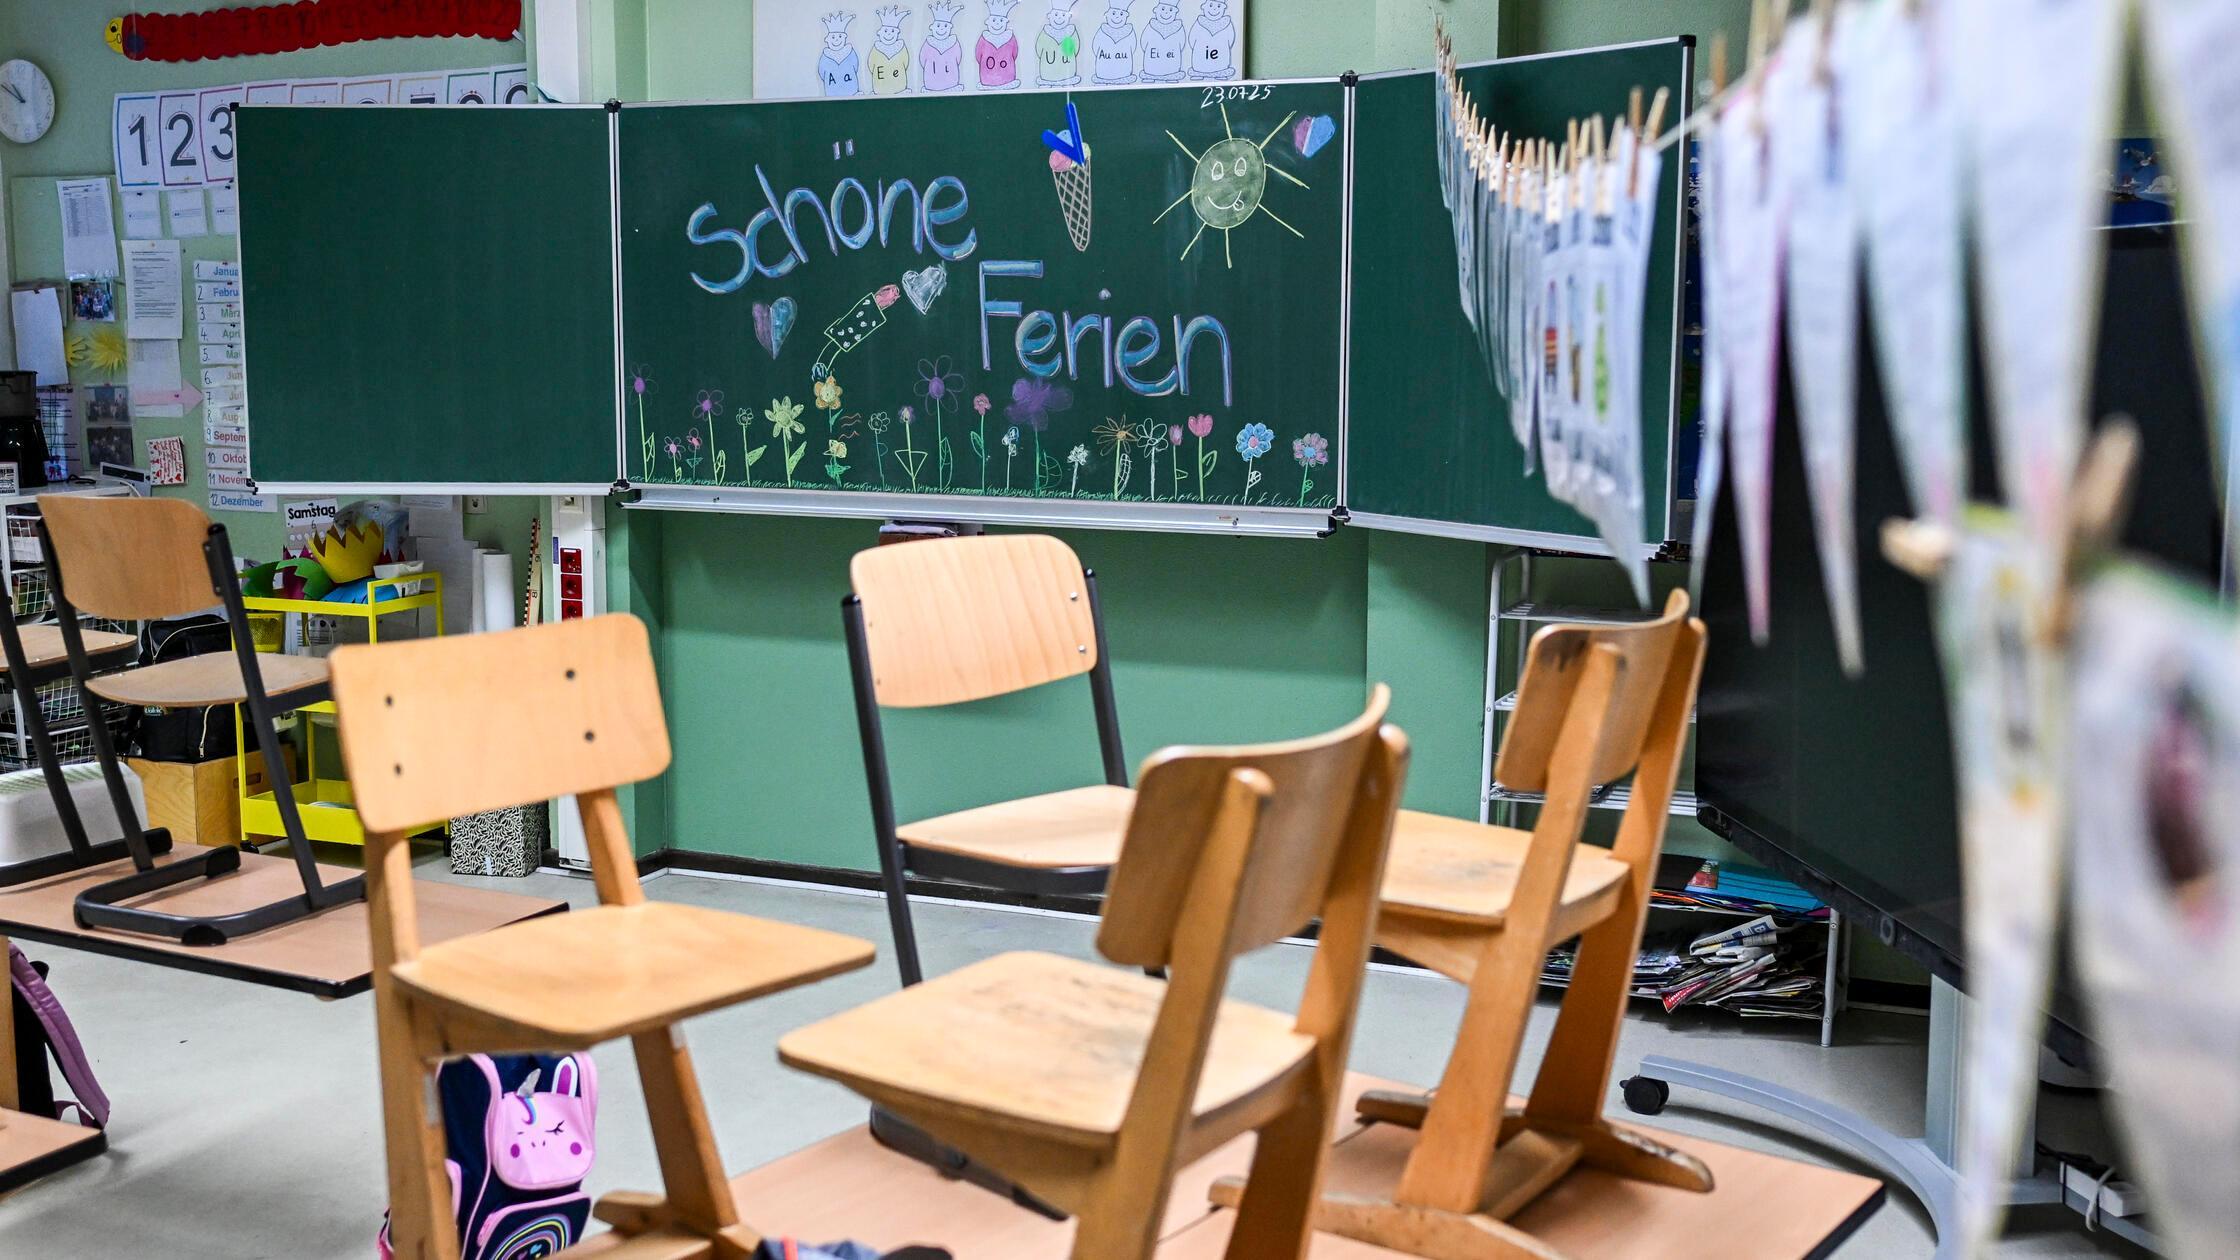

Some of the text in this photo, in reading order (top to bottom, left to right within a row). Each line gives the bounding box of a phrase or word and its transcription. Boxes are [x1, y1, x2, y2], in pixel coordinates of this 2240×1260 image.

[1045, 51, 1056, 65] U
[1099, 50, 1128, 60] Au au
[1150, 49, 1175, 59] Ei ei
[1205, 48, 1219, 60] ie
[986, 56, 1008, 70] O o
[828, 72, 852, 86] A a
[876, 66, 900, 80] E e
[168, 113, 196, 167] 2
[210, 106, 234, 160] 3
[129, 116, 147, 166] 1
[686, 138, 978, 295] Schöne
[979, 260, 1233, 407] Ferien
[221, 495, 264, 507] Dezember
[287, 505, 336, 520] Samstag
